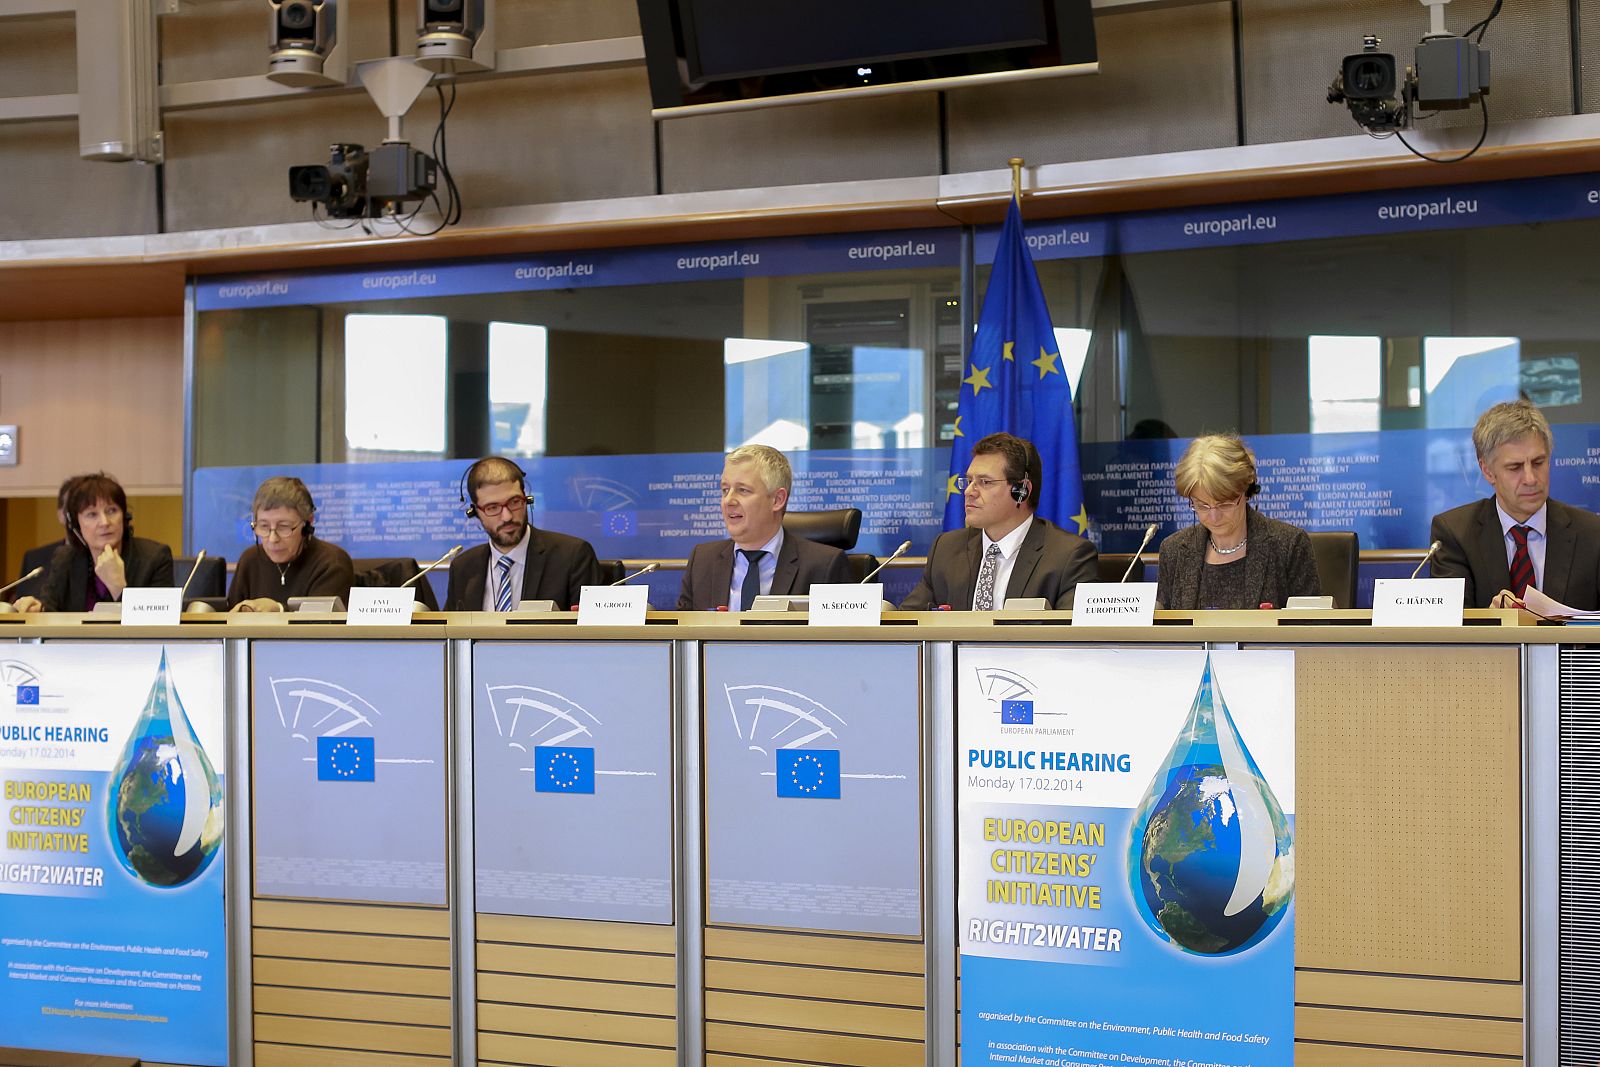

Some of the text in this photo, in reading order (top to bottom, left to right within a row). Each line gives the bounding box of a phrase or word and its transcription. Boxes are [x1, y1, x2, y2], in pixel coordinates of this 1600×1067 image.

[1378, 198, 1478, 220] europarl.eu
[1184, 214, 1277, 236] europarl.eu
[1025, 229, 1090, 250] oparl.eu
[677, 250, 760, 271] europarl.eu
[848, 240, 936, 261] europarl.eu
[363, 272, 437, 289] europarl.eu
[515, 260, 594, 281] europarl.eu
[219, 282, 289, 299] europarl.eu
[1337, 455, 1380, 464] PARLAMENT
[1350, 490, 1392, 499] PARLAMENT
[1360, 507, 1403, 516] PARLAMENT
[1085, 606, 1141, 614] EUROPEENNE
[1395, 595, 1444, 605] G. HÄFNER
[0, 726, 109, 742] UBLIC HEARING
[1000, 727, 1075, 736] EUROPEAN PARLIAMENT
[0, 747, 76, 760] onday 17.02.2014
[968, 749, 1131, 773] PUBLIC HEARING
[5, 780, 91, 802] EUROPEAN
[968, 775, 1083, 792] Monday 17.02.2014
[7, 831, 89, 852] INITIATIVE
[983, 817, 1105, 847] EUROPEAN
[987, 880, 1101, 910] INITIATIVE
[969, 918, 1122, 952] RIGHT2WATER
[978, 1011, 1271, 1046] organised by the Committee on the Environment, Public Health and Food Safety
[988, 1040, 996, 1049] in
[996, 1042, 1037, 1053] association
[1037, 1044, 1055, 1055] with
[1055, 1045, 1067, 1056] the
[1068, 1047, 1108, 1060] Committee
[1109, 1053, 1120, 1061] on
[1120, 1053, 1172, 1067] Development,
[1173, 1057, 1186, 1067] the
[989, 1052, 1018, 1063] Internal
[1018, 1055, 1044, 1065] Market
[1045, 1057, 1061, 1067] and
